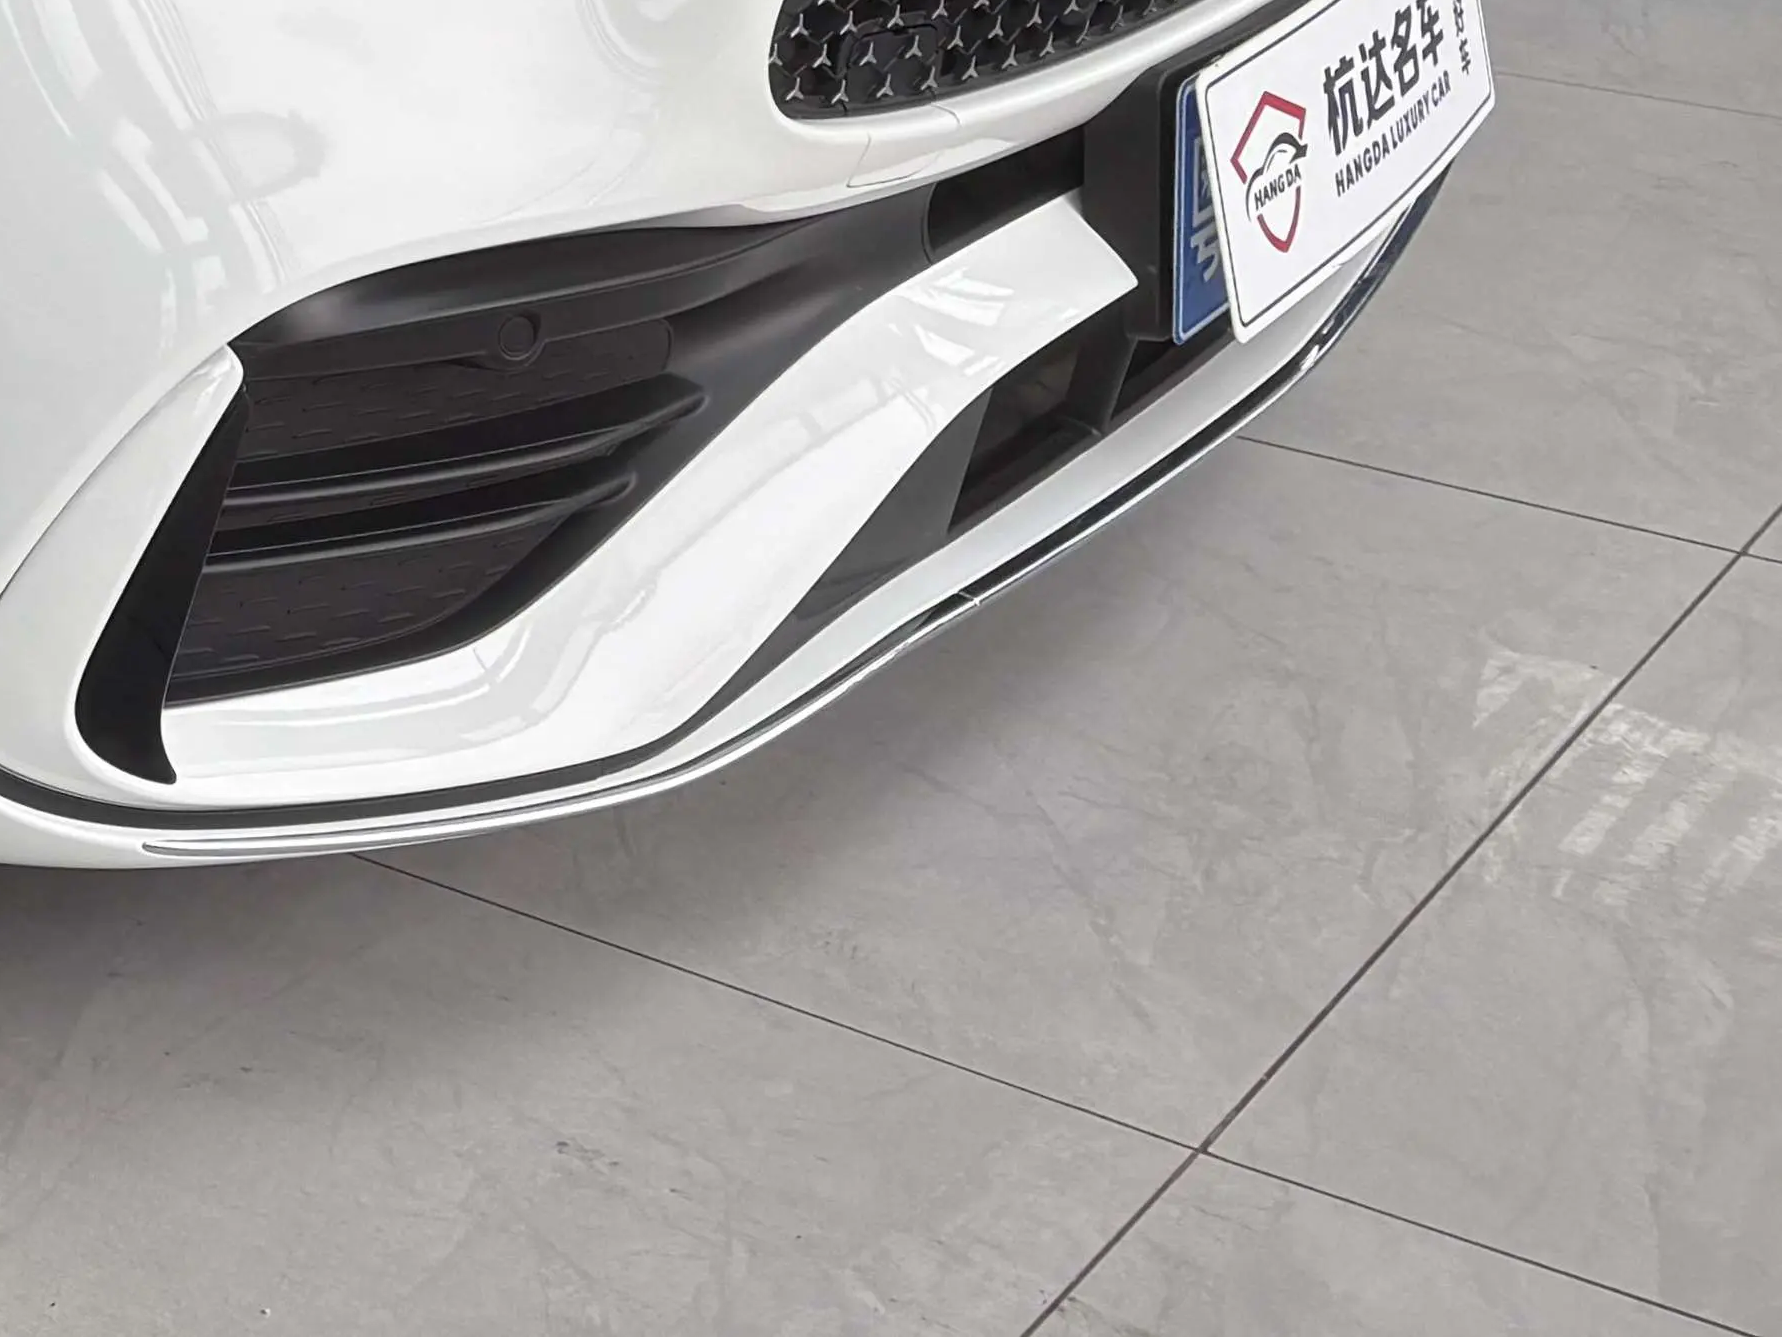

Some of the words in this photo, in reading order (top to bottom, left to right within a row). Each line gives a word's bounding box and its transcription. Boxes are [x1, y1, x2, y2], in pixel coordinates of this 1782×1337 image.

[1335, 132, 1390, 197] HANGDA
[1390, 90, 1429, 150] LUXURY
[1431, 69, 1451, 107] CAR
[1254, 174, 1285, 211] HANG
[1285, 163, 1302, 187] DA
